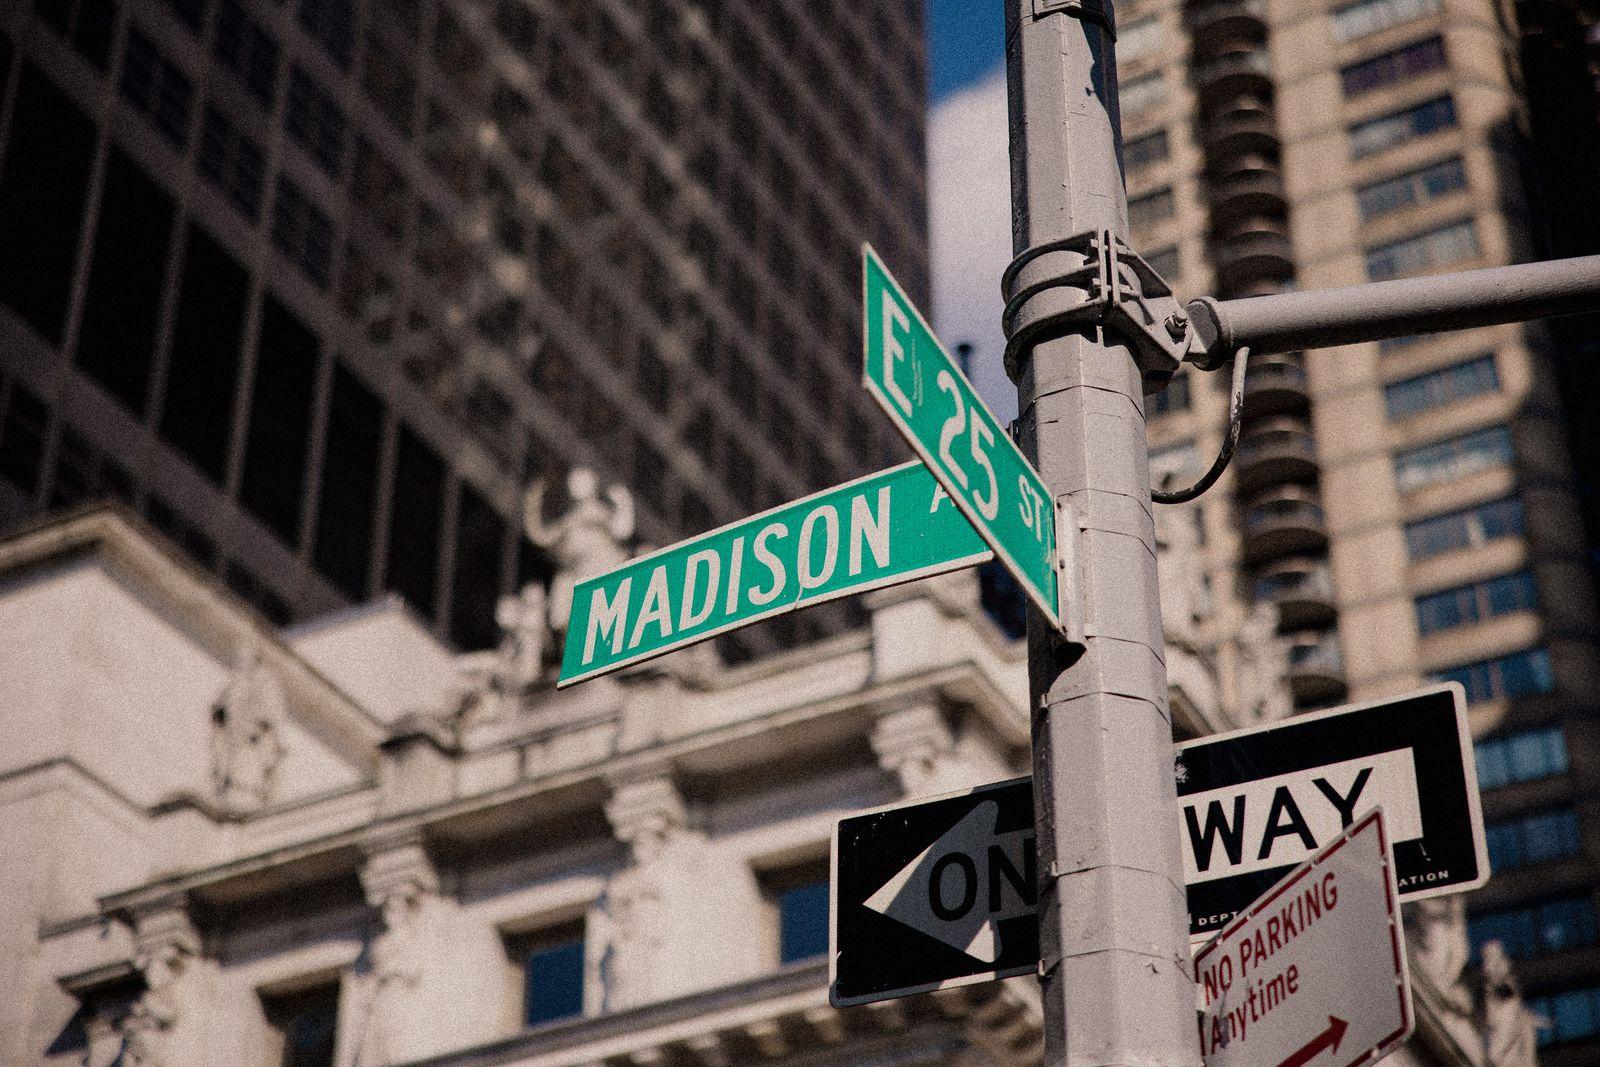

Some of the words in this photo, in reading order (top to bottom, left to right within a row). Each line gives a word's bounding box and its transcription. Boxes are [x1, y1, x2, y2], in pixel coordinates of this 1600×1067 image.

[882, 287, 913, 418] E
[936, 369, 998, 522] 25
[1017, 474, 1044, 543] ST
[580, 486, 891, 666] MADISON
[928, 837, 1037, 922] ON
[1183, 767, 1374, 872] WAY
[1204, 955, 1233, 1007] NO
[1239, 872, 1338, 978] PARKING
[1211, 963, 1299, 1056] Anytime
